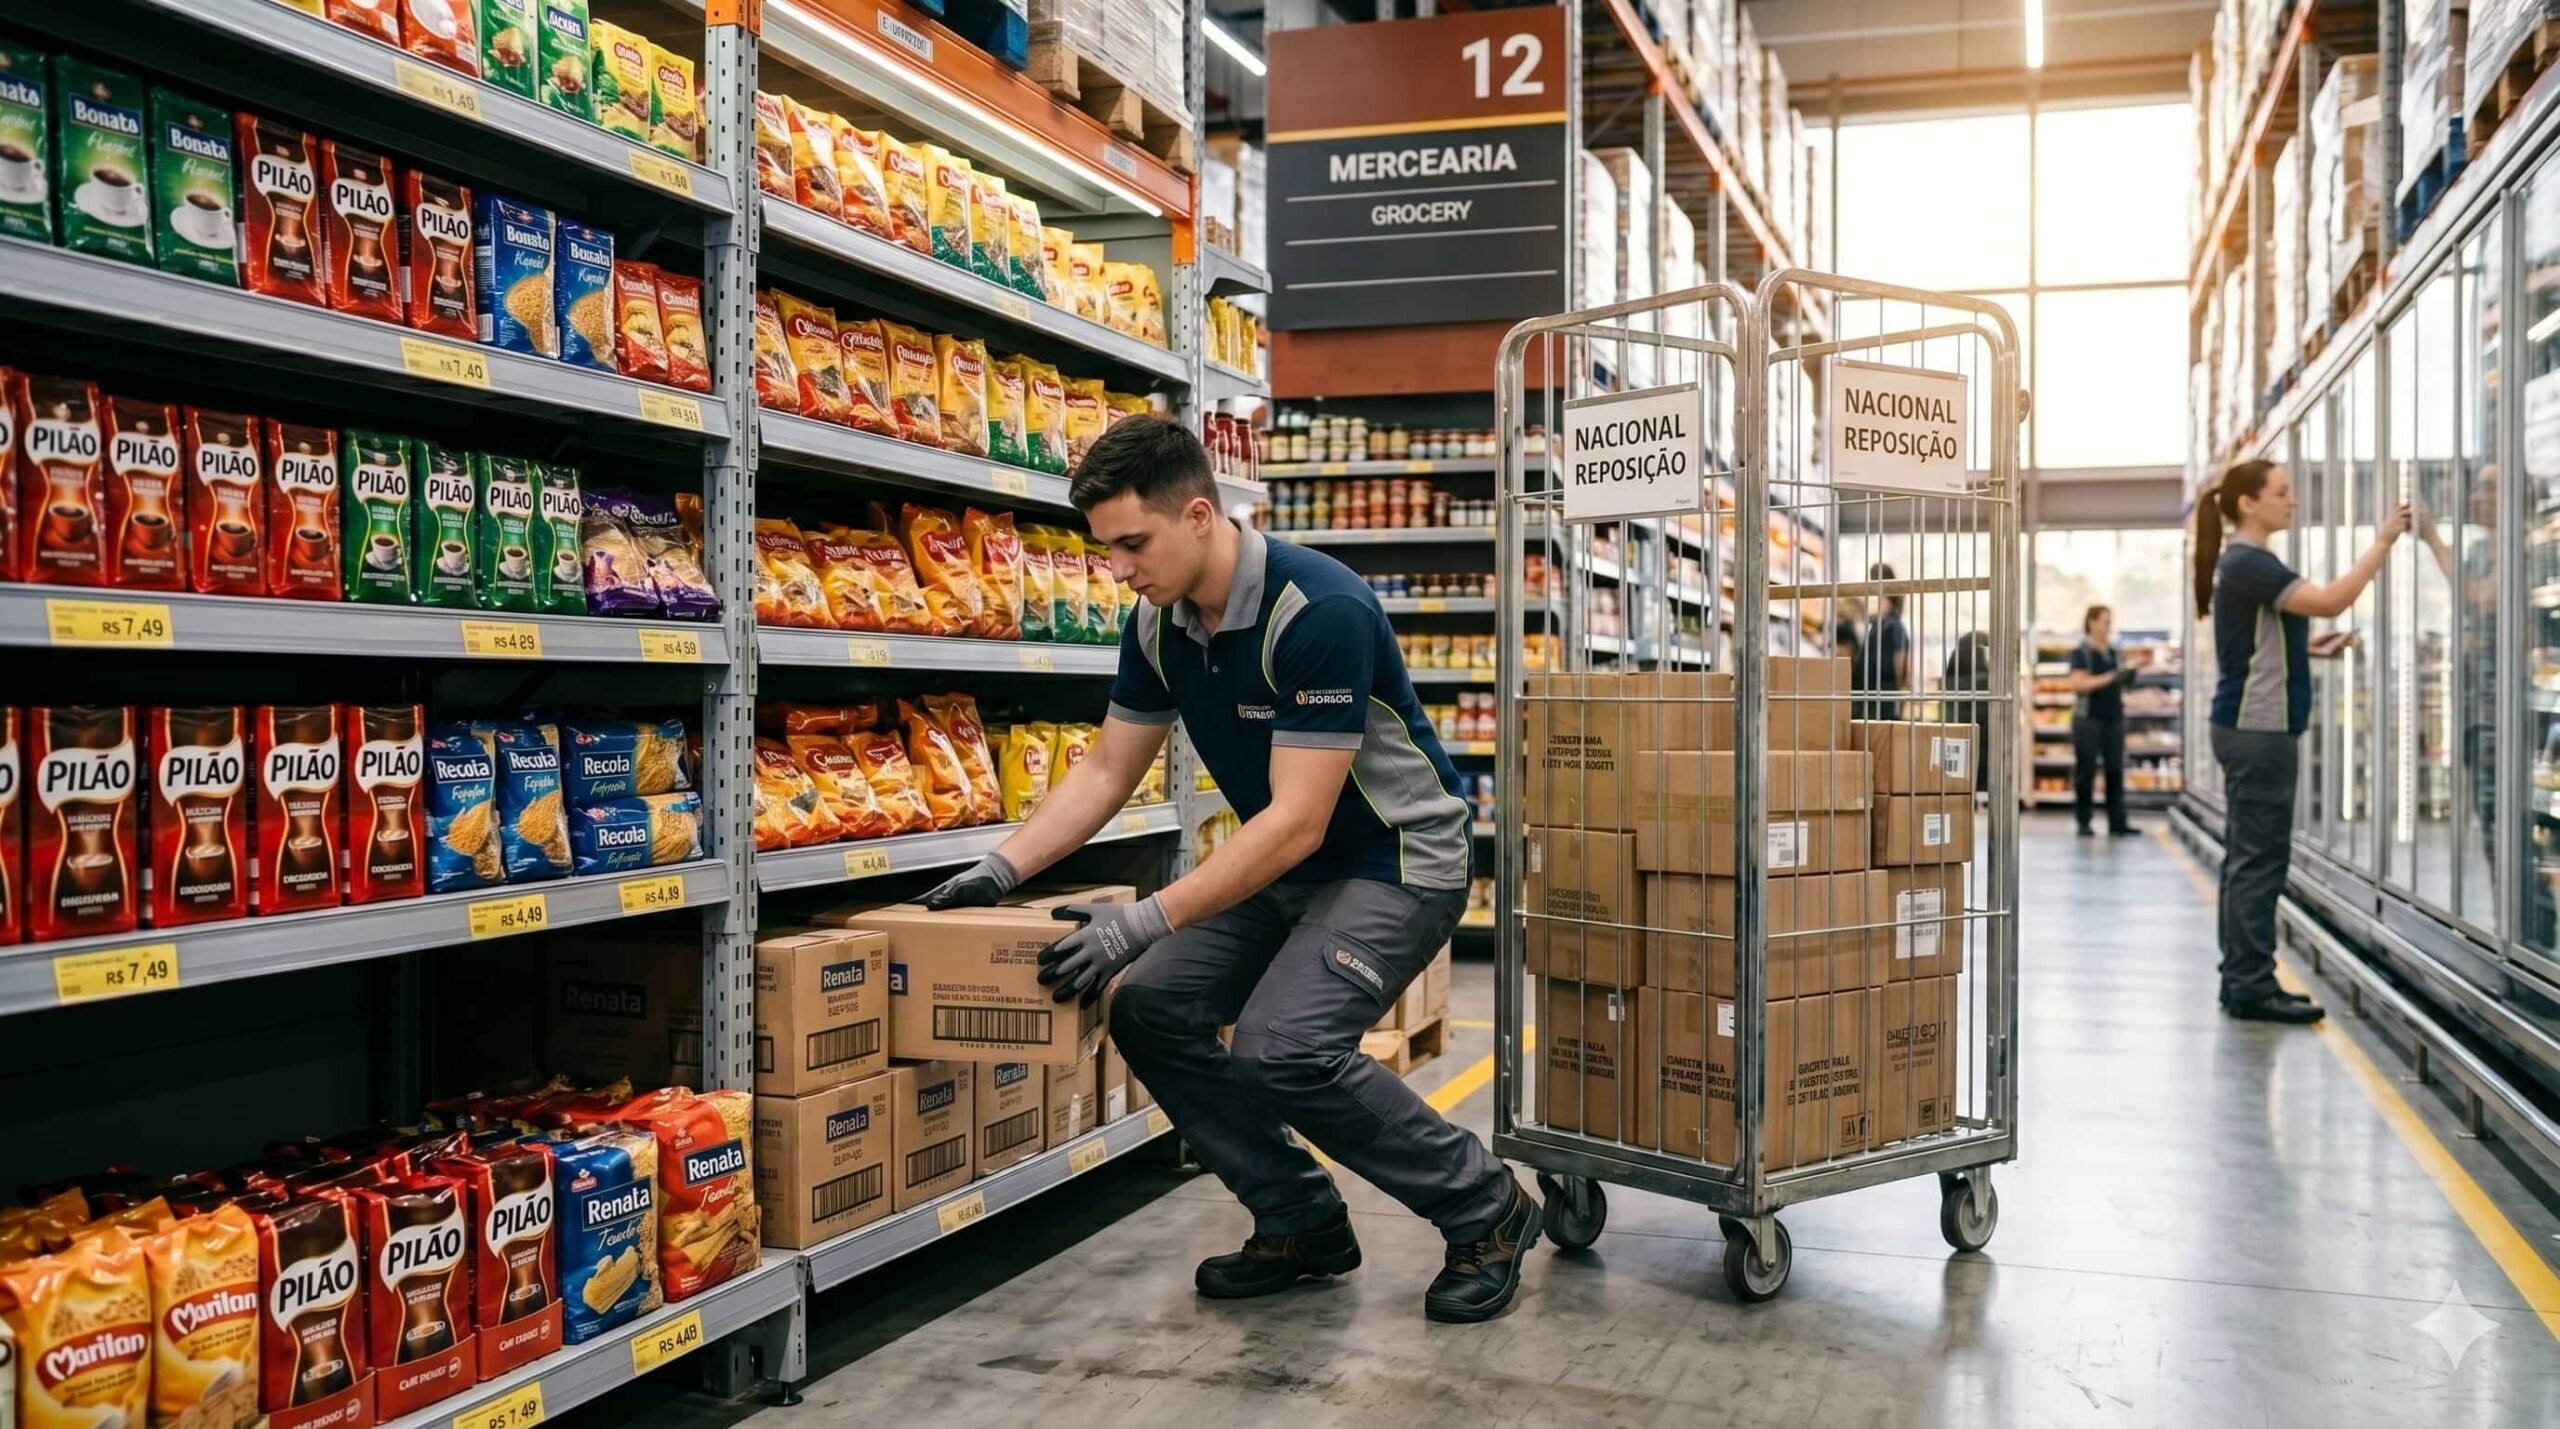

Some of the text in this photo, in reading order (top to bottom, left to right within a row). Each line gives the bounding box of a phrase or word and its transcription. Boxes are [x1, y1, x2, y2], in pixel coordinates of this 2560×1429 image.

[1461, 33, 1545, 99] 12
[257, 160, 312, 196] PILÃO
[1329, 143, 1518, 182] MERCEARIA
[336, 183, 390, 217] PILÃO
[1371, 200, 1472, 225] GROCERY
[421, 208, 468, 240] PILÃO
[1845, 388, 1957, 424] NACIONAL
[33, 427, 97, 456] PILÃO
[1575, 413, 1686, 452] NACIONAL
[1845, 425, 1957, 463] REPOSIÇÃO
[116, 439, 176, 468] PILÃO
[201, 450, 256, 478] PILÃO
[1575, 447, 1686, 486] REPOSIÇÃO
[281, 458, 335, 486] PILÃO
[357, 470, 406, 496] PILÃO
[429, 478, 473, 504] PILÃO
[490, 485, 532, 511] PILÃO
[542, 489, 581, 516] PILÃO
[123, 618, 164, 639] 7,49
[46, 754, 130, 792] PILÃO
[167, 751, 239, 787] PILÃO
[271, 748, 336, 782] PILÃO
[361, 746, 421, 777] PILÃO
[106, 959, 168, 987] R$ 7,49
[823, 966, 863, 988] Renata
[688, 1148, 744, 1182] Renata
[492, 1193, 552, 1241] PILÃO
[588, 1186, 651, 1225] Renata
[387, 1226, 461, 1276] PILÃO
[279, 1253, 355, 1314] PILÃO
[170, 1289, 257, 1335] Marilan
[45, 1330, 146, 1382] Marilan
